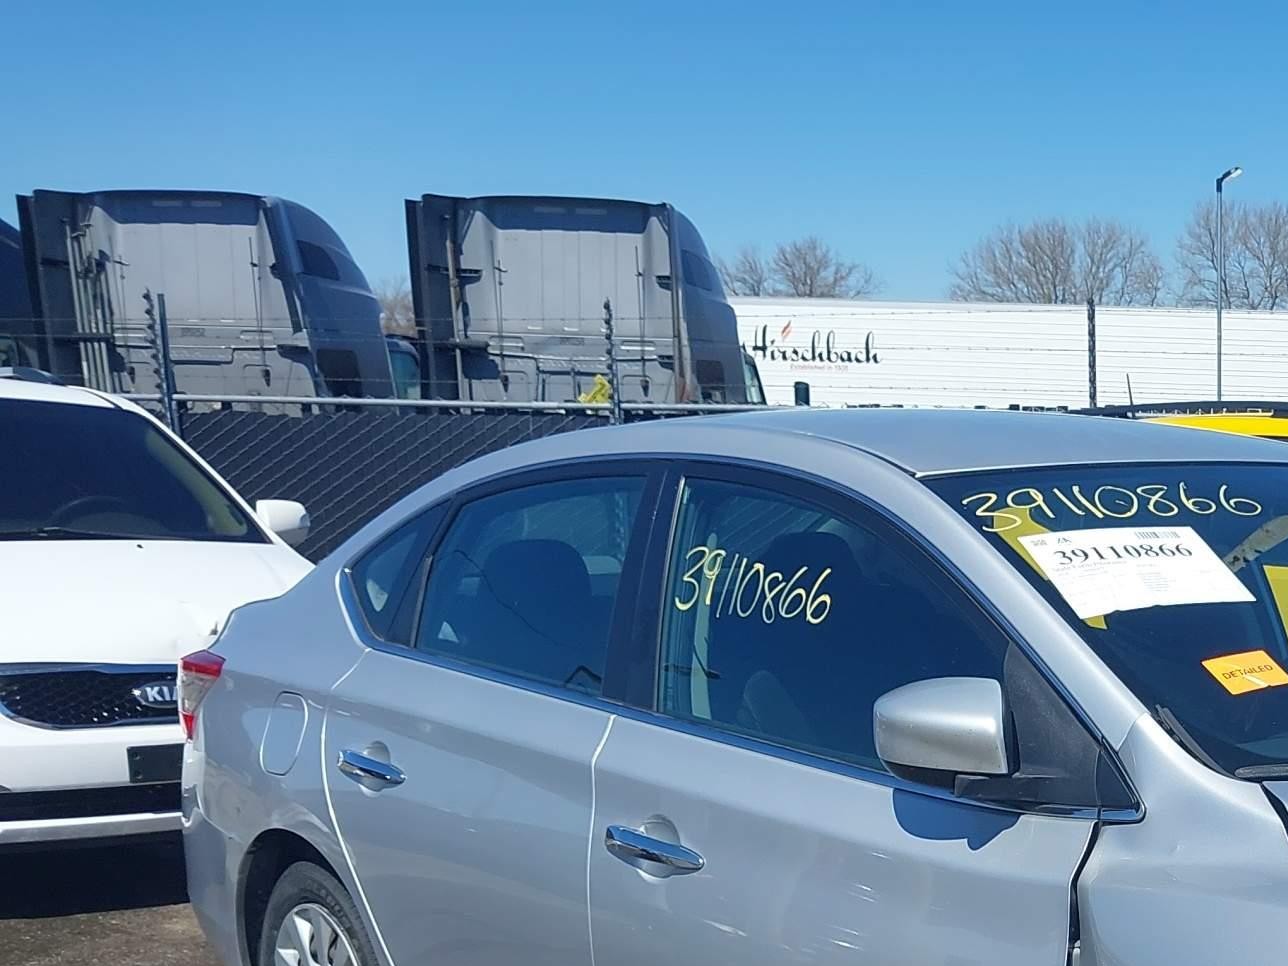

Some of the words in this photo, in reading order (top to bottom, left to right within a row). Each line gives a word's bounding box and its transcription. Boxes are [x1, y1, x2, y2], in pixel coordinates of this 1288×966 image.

[741, 324, 883, 364] Hirschbach
[961, 481, 1262, 532] 39110866
[1054, 543, 1193, 565] 39110866
[675, 546, 832, 624] 39110866
[1222, 664, 1274, 680] DETAILED
